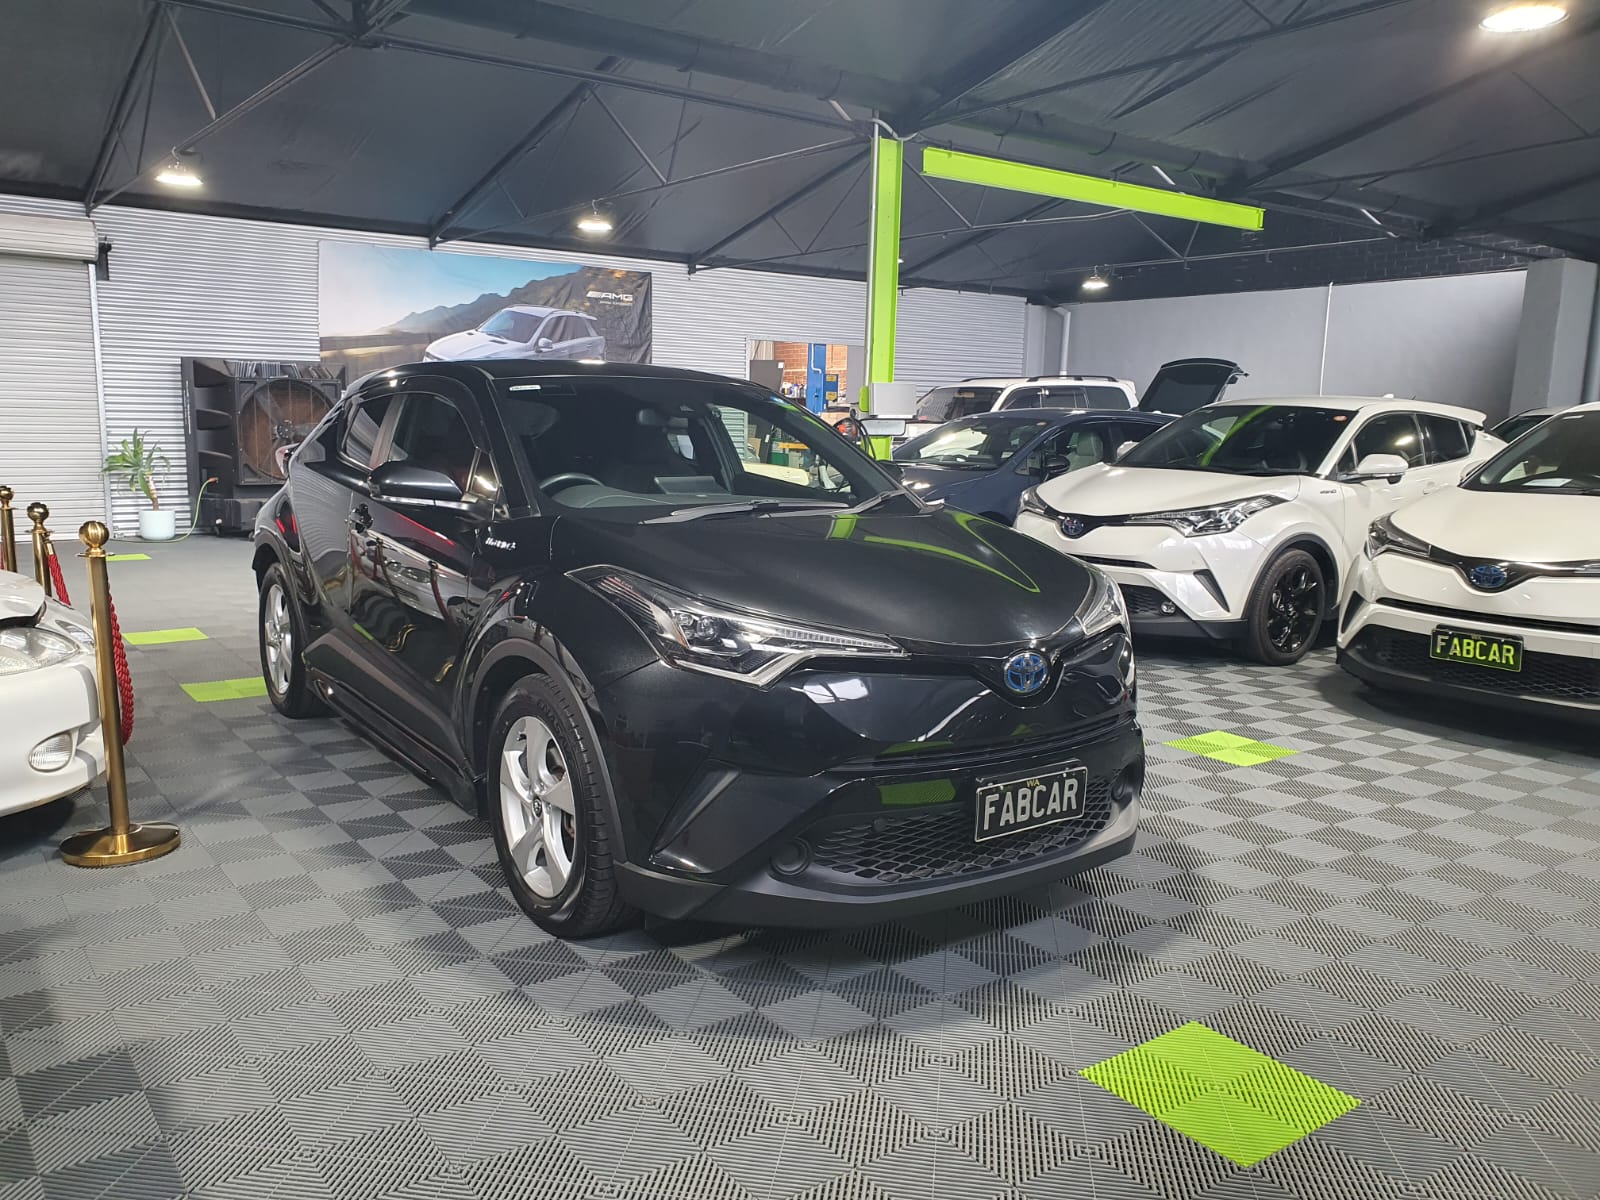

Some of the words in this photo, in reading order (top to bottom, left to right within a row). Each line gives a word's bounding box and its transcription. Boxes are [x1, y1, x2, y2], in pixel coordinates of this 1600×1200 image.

[601, 292, 633, 302] AMG
[1436, 635, 1514, 665] FABCAR
[1026, 779, 1040, 788] WA
[983, 778, 1079, 830] FABCAR
